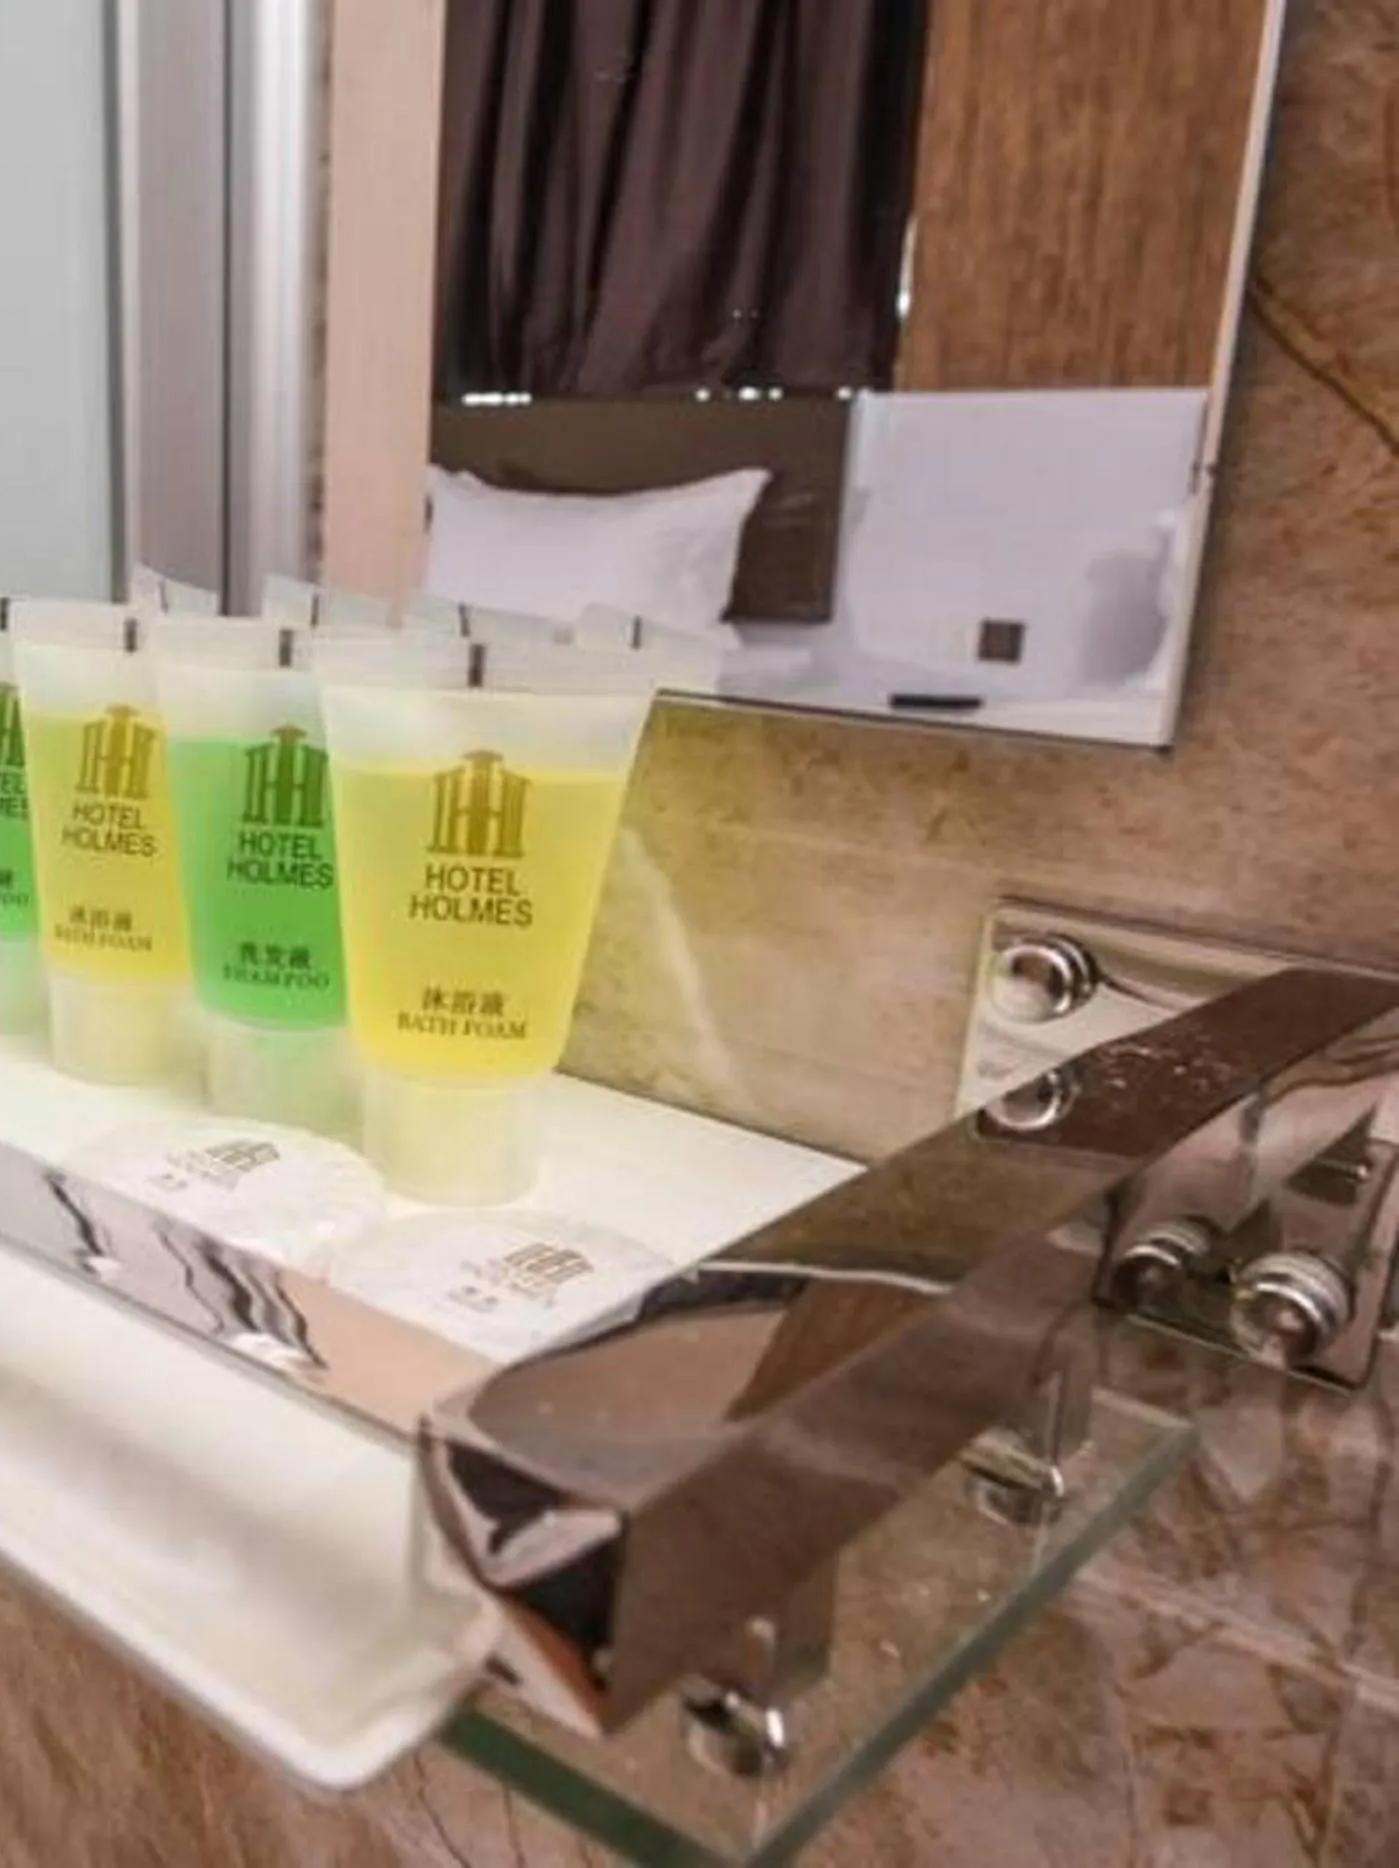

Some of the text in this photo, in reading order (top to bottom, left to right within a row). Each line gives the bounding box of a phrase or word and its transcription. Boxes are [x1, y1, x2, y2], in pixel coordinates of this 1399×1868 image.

[71, 802, 146, 830] HOTEL
[62, 828, 155, 856] HOLMES
[238, 833, 322, 862] HOTEL
[228, 859, 332, 888] HOLMES
[425, 865, 520, 895] HOTEL
[408, 896, 532, 927] HOLMES
[224, 964, 330, 986] SHAMPOO
[398, 1012, 527, 1040] BATH FOAM
